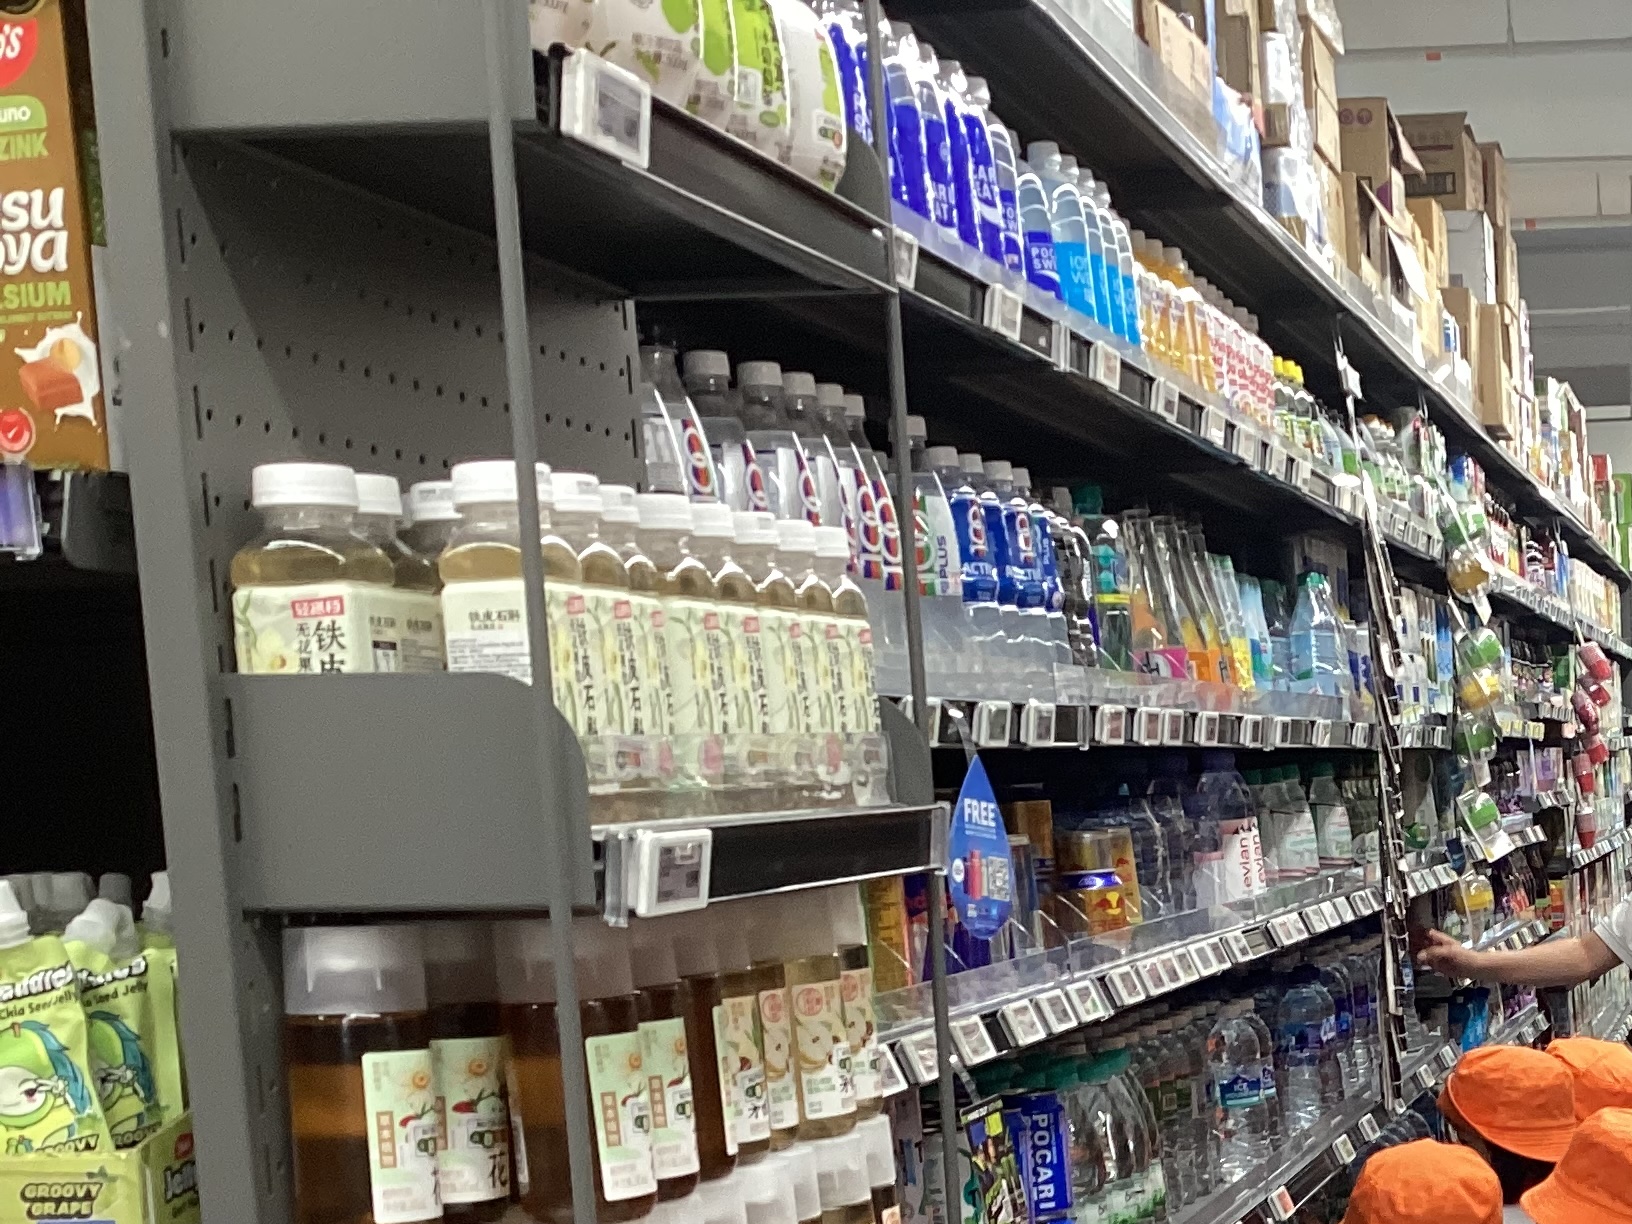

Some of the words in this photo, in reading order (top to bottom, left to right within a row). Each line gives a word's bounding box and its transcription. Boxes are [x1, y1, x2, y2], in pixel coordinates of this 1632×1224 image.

[0, 187, 65, 231] su
[0, 230, 68, 275] ya
[964, 797, 997, 828] FREE
[1239, 837, 1252, 889] evian
[1032, 1112, 1056, 1210] POCARI
[23, 1182, 102, 1200] GROOVY
